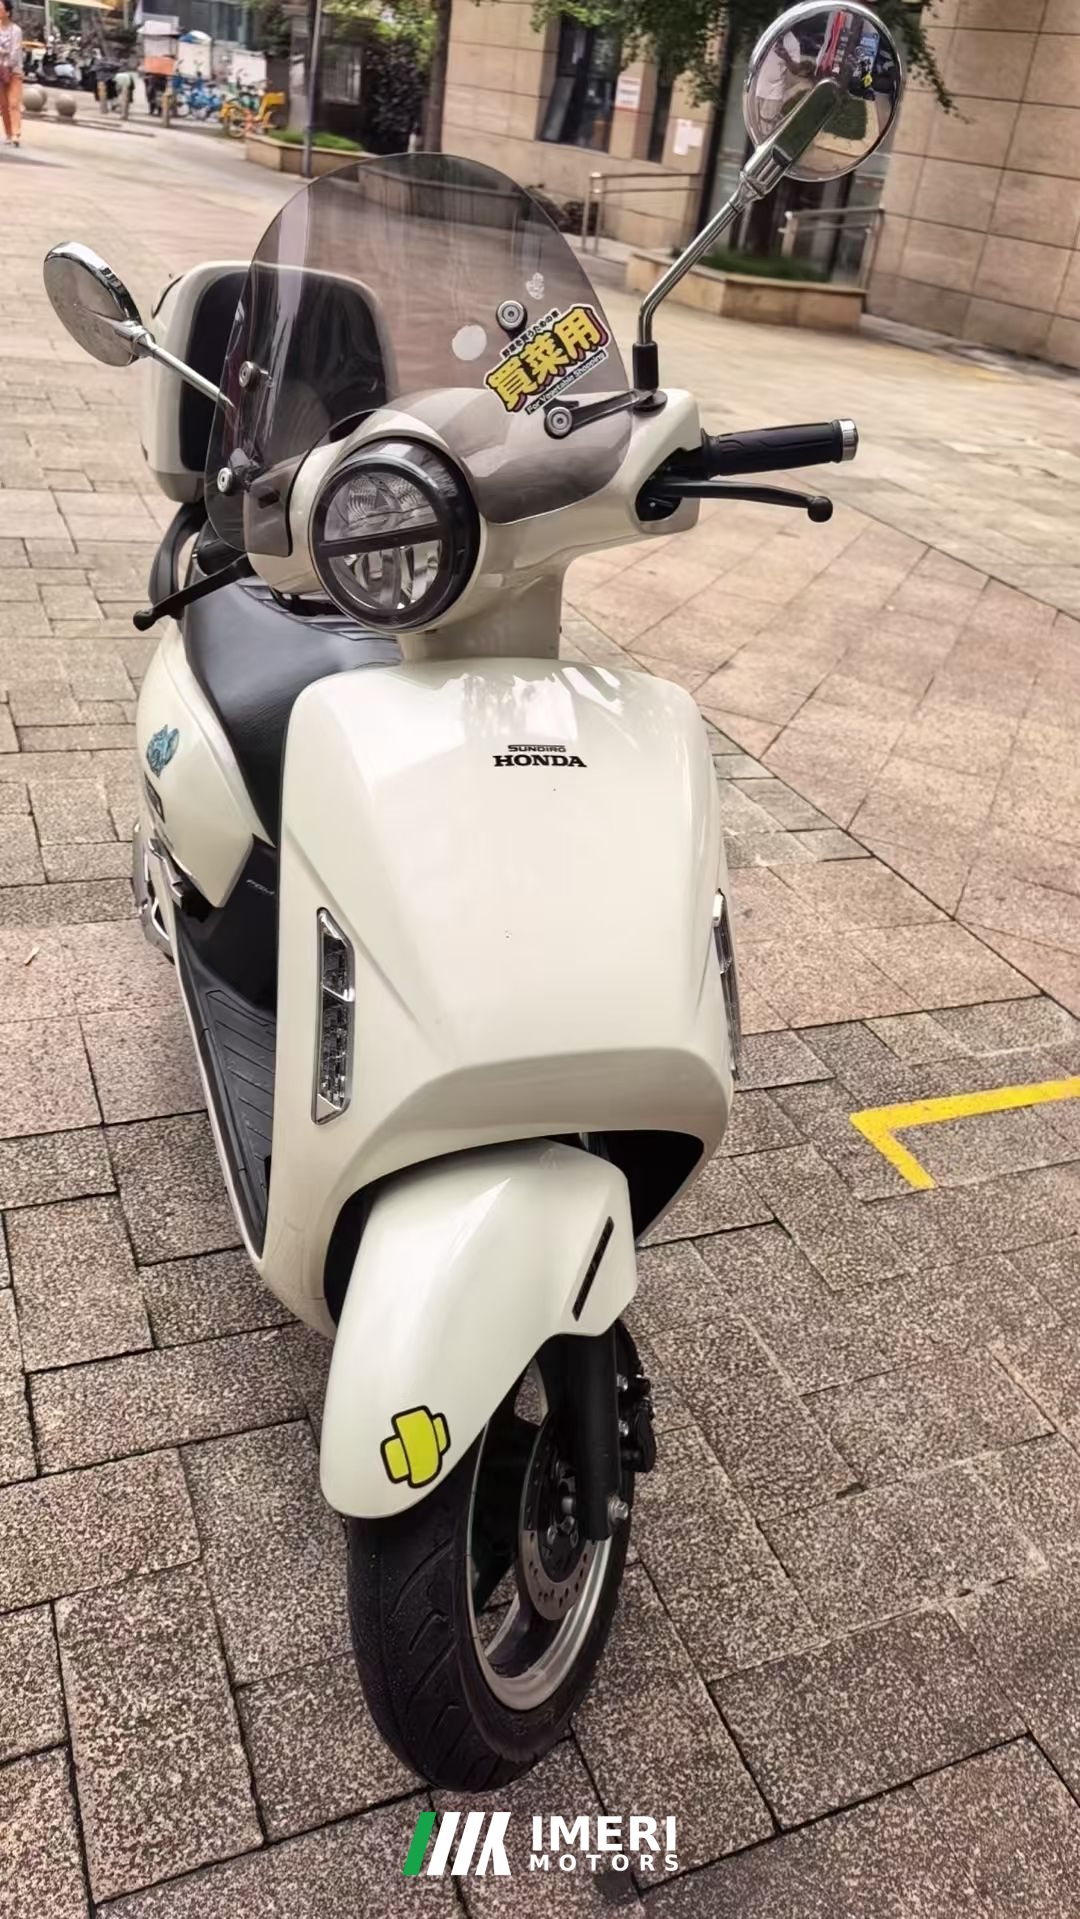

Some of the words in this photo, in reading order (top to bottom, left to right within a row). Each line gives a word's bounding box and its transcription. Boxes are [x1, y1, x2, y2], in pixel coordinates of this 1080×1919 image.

[486, 306, 609, 412] 買菜用
[526, 400, 541, 413] For
[507, 744, 567, 753] SUNDIRO
[492, 754, 588, 768] HONDA
